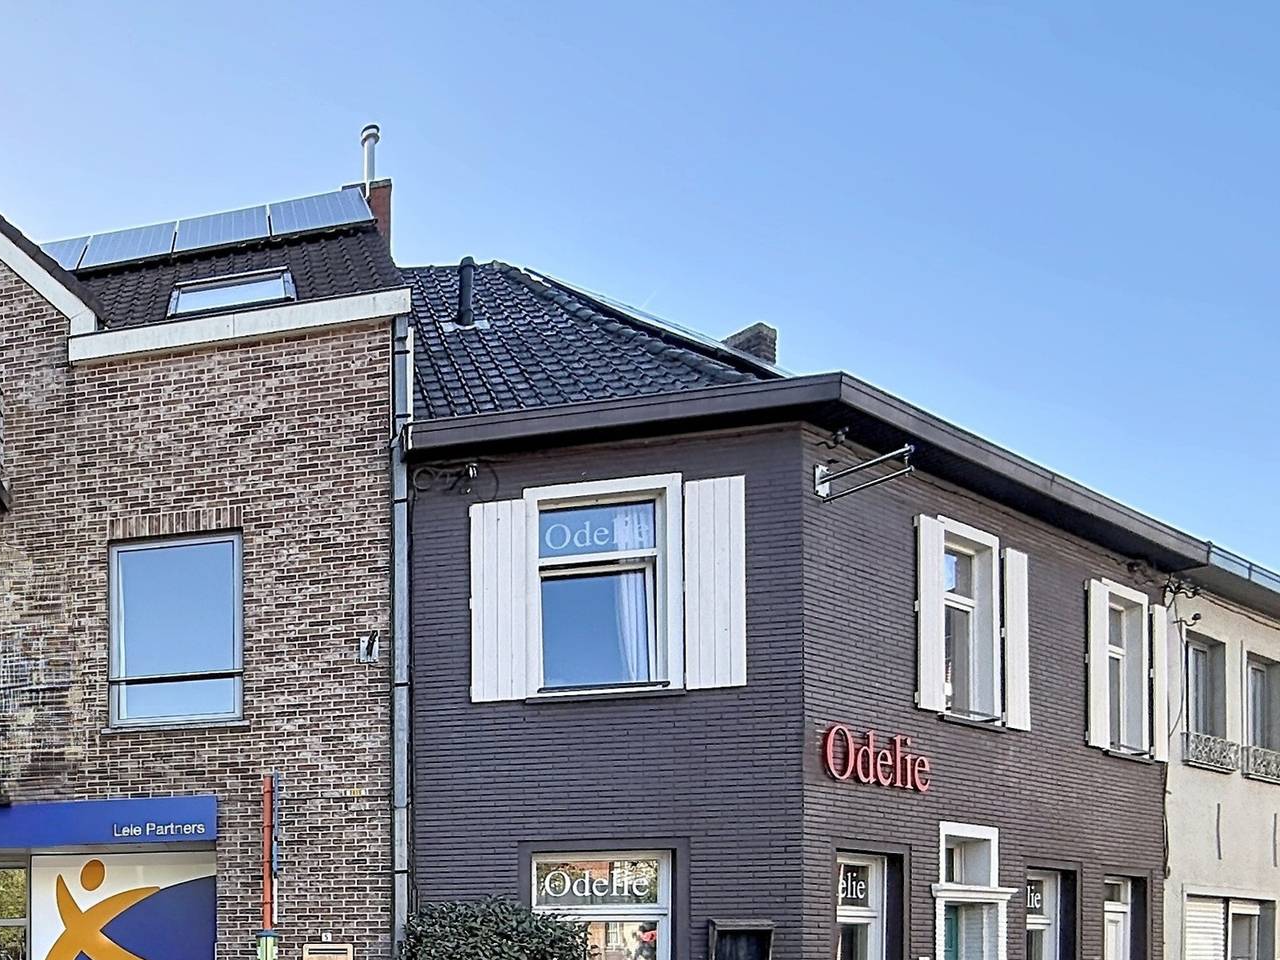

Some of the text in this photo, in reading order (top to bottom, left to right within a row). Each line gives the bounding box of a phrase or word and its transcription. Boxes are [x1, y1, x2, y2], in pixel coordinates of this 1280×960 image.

[826, 725, 930, 792] Odelie
[113, 822, 206, 837] Leie Partners
[836, 872, 866, 899] elie
